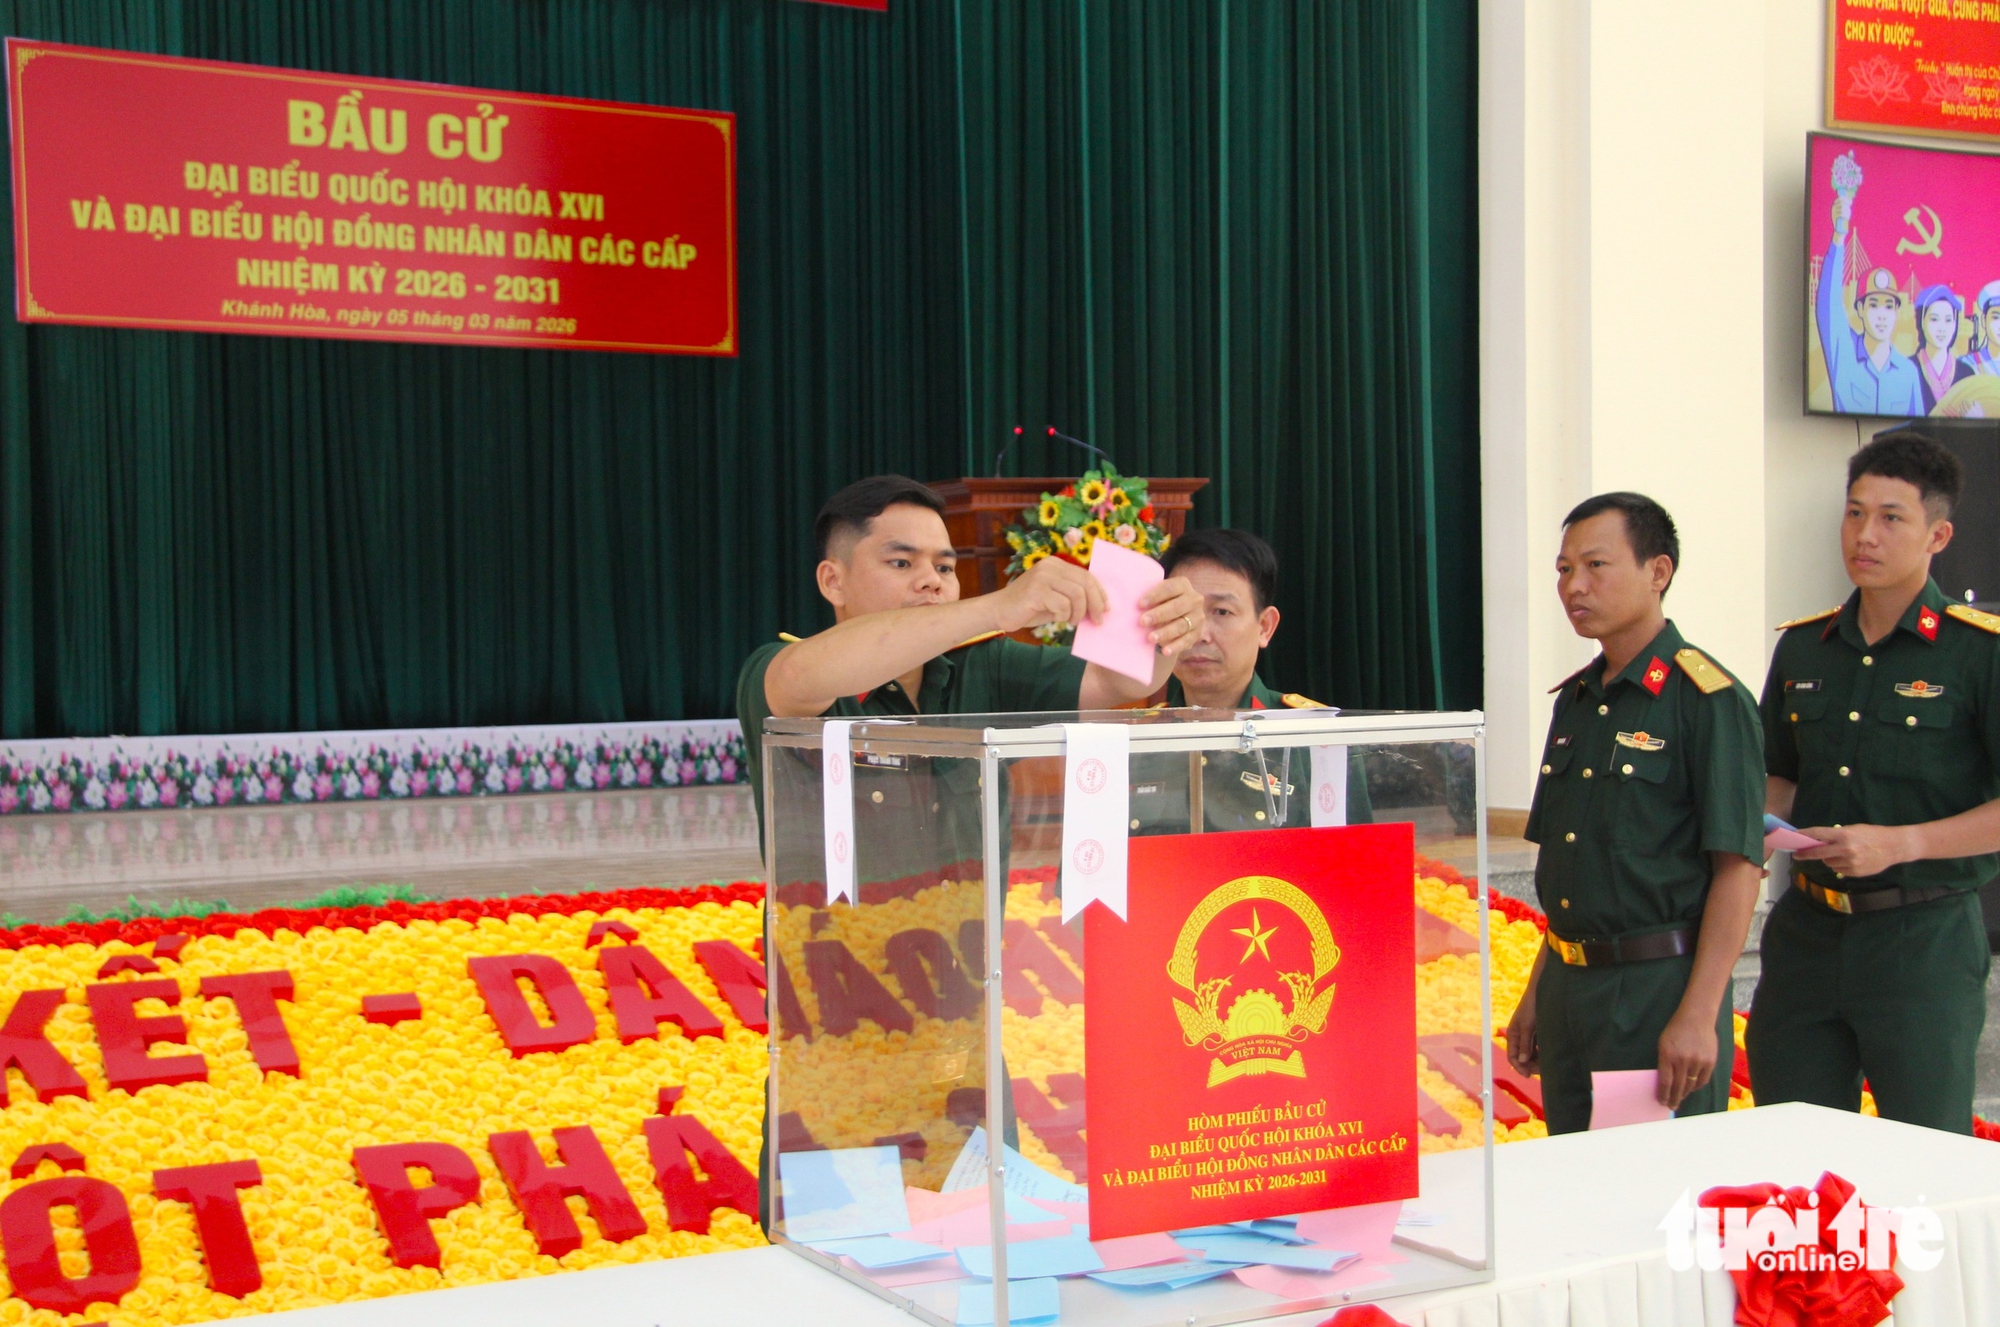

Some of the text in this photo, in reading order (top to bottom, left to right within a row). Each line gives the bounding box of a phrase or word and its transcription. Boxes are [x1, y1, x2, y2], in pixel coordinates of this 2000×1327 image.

[1845, 20, 1866, 41] CHO
[1868, 18, 1881, 42] KỲ
[288, 90, 509, 162] BẦU CỬ
[184, 158, 605, 221] ĐẠI BIỂU QUỐC HỘI KHÓA XVI
[70, 196, 698, 270] VÀ ĐẠI BIỂU HỘI ĐỒNG NHÂN DÂN CÁC CẤP
[237, 257, 561, 304] NHIỆM KỲ 2026 - 2031
[221, 299, 577, 334] Khánh Hòa, ngày 05 tháng 03 năm 2026
[362, 993, 421, 1027] -
[1231, 1046, 1281, 1060] VIỆT NAM
[1188, 1098, 1327, 1131] HÒM PHIẾU BẦU CỬ
[1102, 1132, 1408, 1188] VÀ ĐẠI BIỂU HỘI ĐỒNG NHÂN DÂN CÁC CẤP
[1149, 1120, 1363, 1161] ĐẠI BIỂU QUỐC HỘI KHÓA XVI
[353, 1085, 760, 1270] PHÁ
[1190, 1169, 1327, 1200] NHIỆM KỲ 2026-2031
